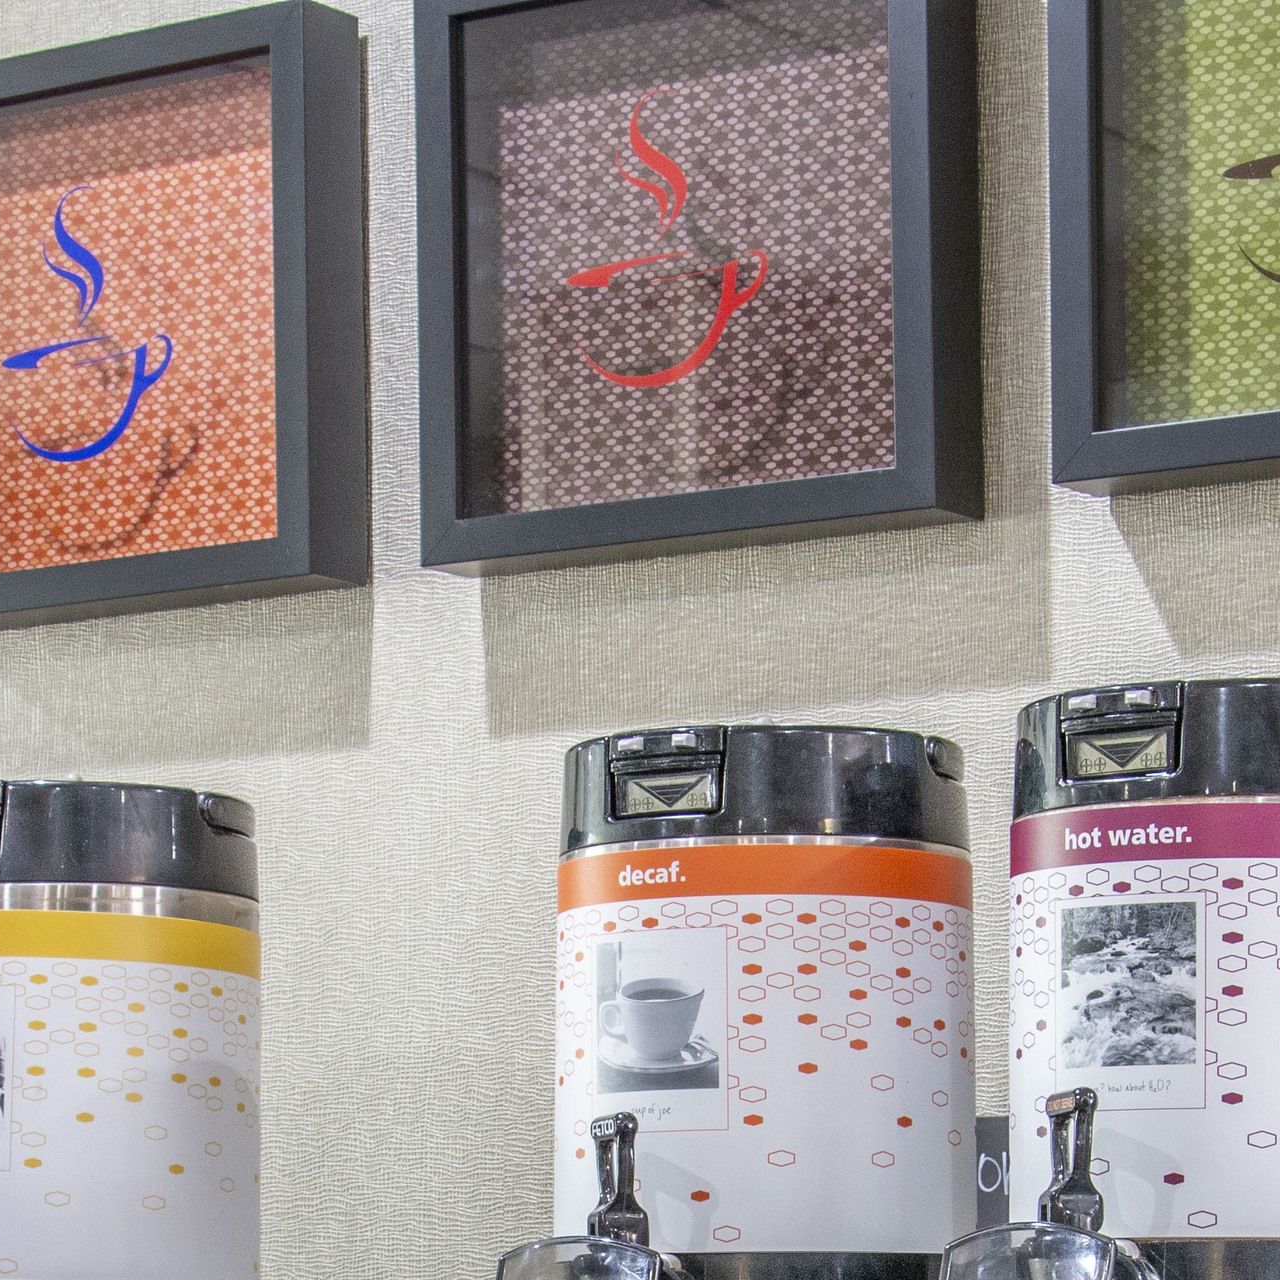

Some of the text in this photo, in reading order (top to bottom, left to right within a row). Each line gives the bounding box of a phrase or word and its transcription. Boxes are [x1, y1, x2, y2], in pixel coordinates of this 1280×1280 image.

[1064, 823, 1193, 850] hot water.
[618, 860, 687, 887] decaf.
